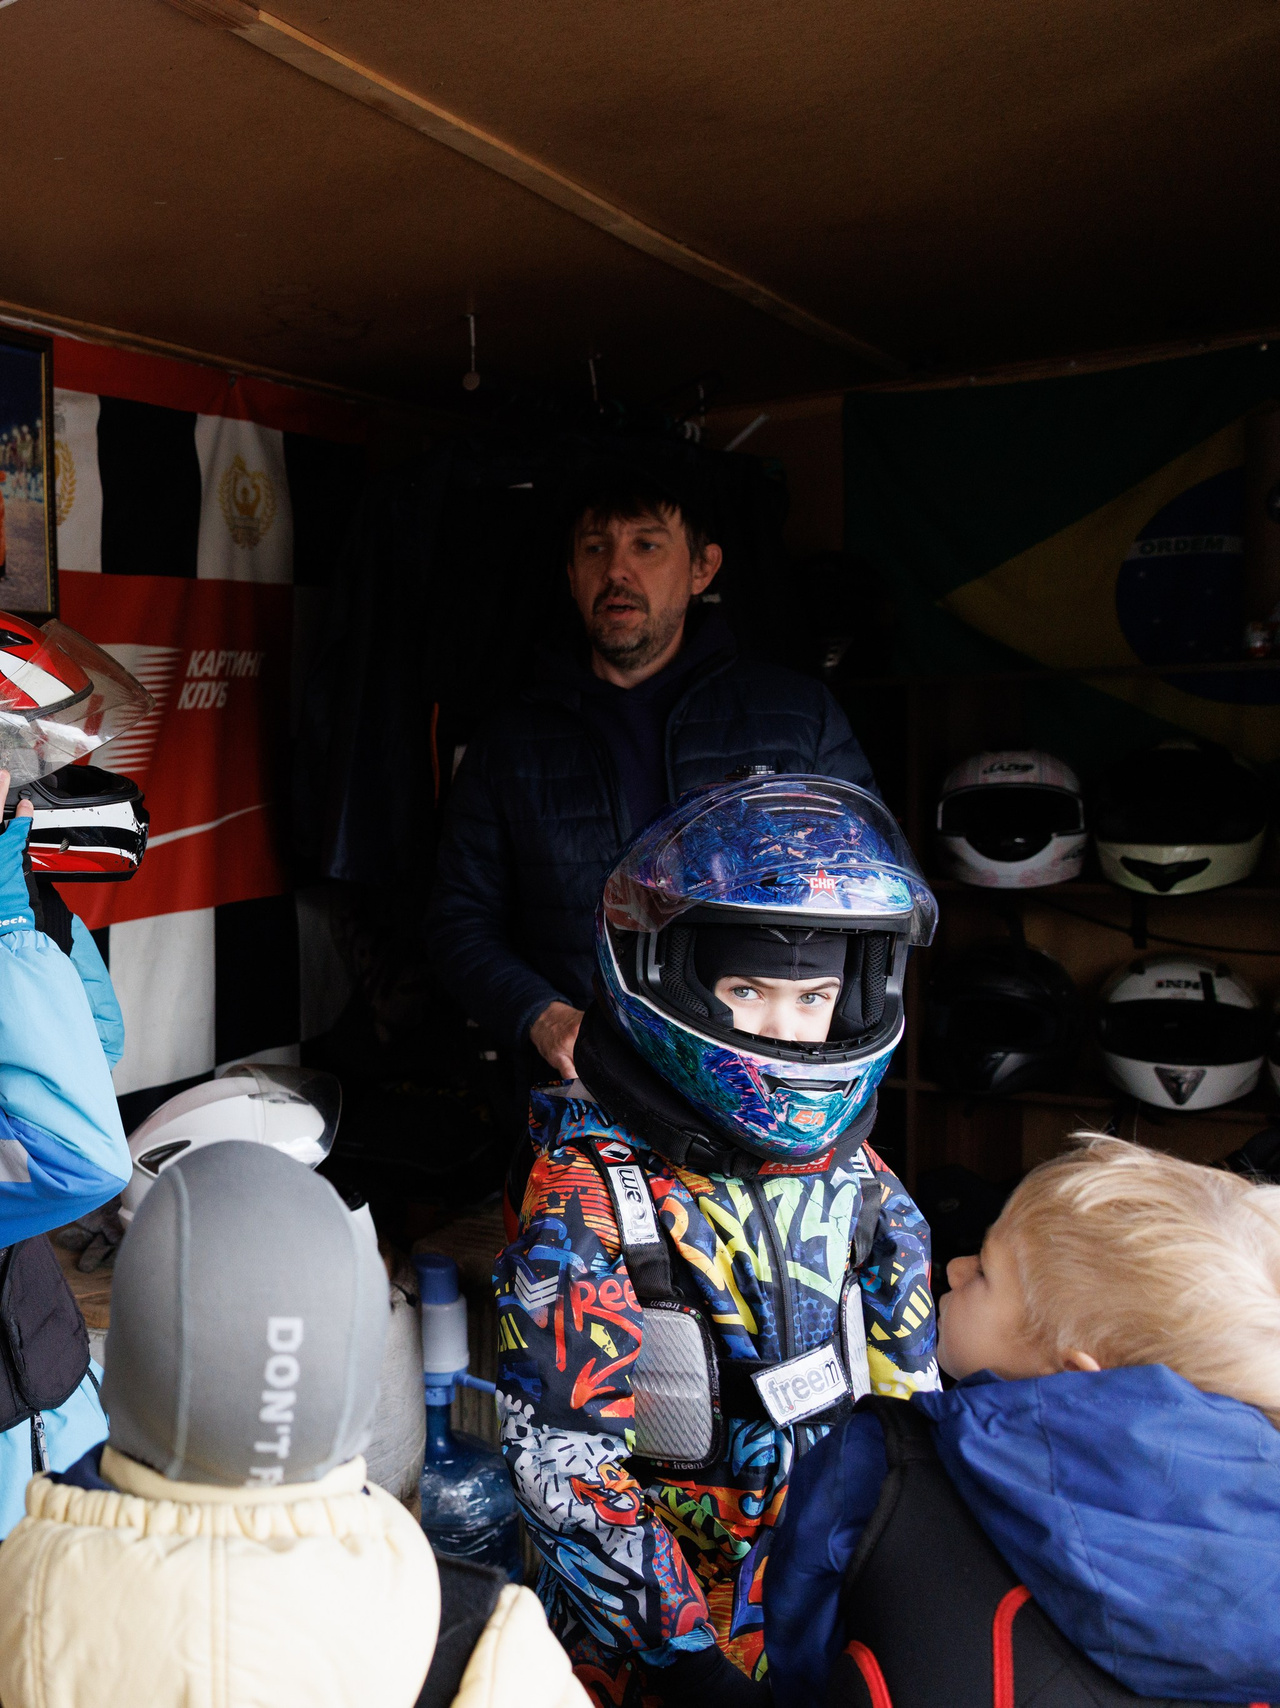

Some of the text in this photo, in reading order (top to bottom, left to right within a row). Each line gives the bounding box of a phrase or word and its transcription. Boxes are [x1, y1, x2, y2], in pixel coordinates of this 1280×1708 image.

[177, 681, 229, 710] КЛУБ
[252, 1316, 304, 1459] DON'T
[766, 1359, 841, 1415] freem
